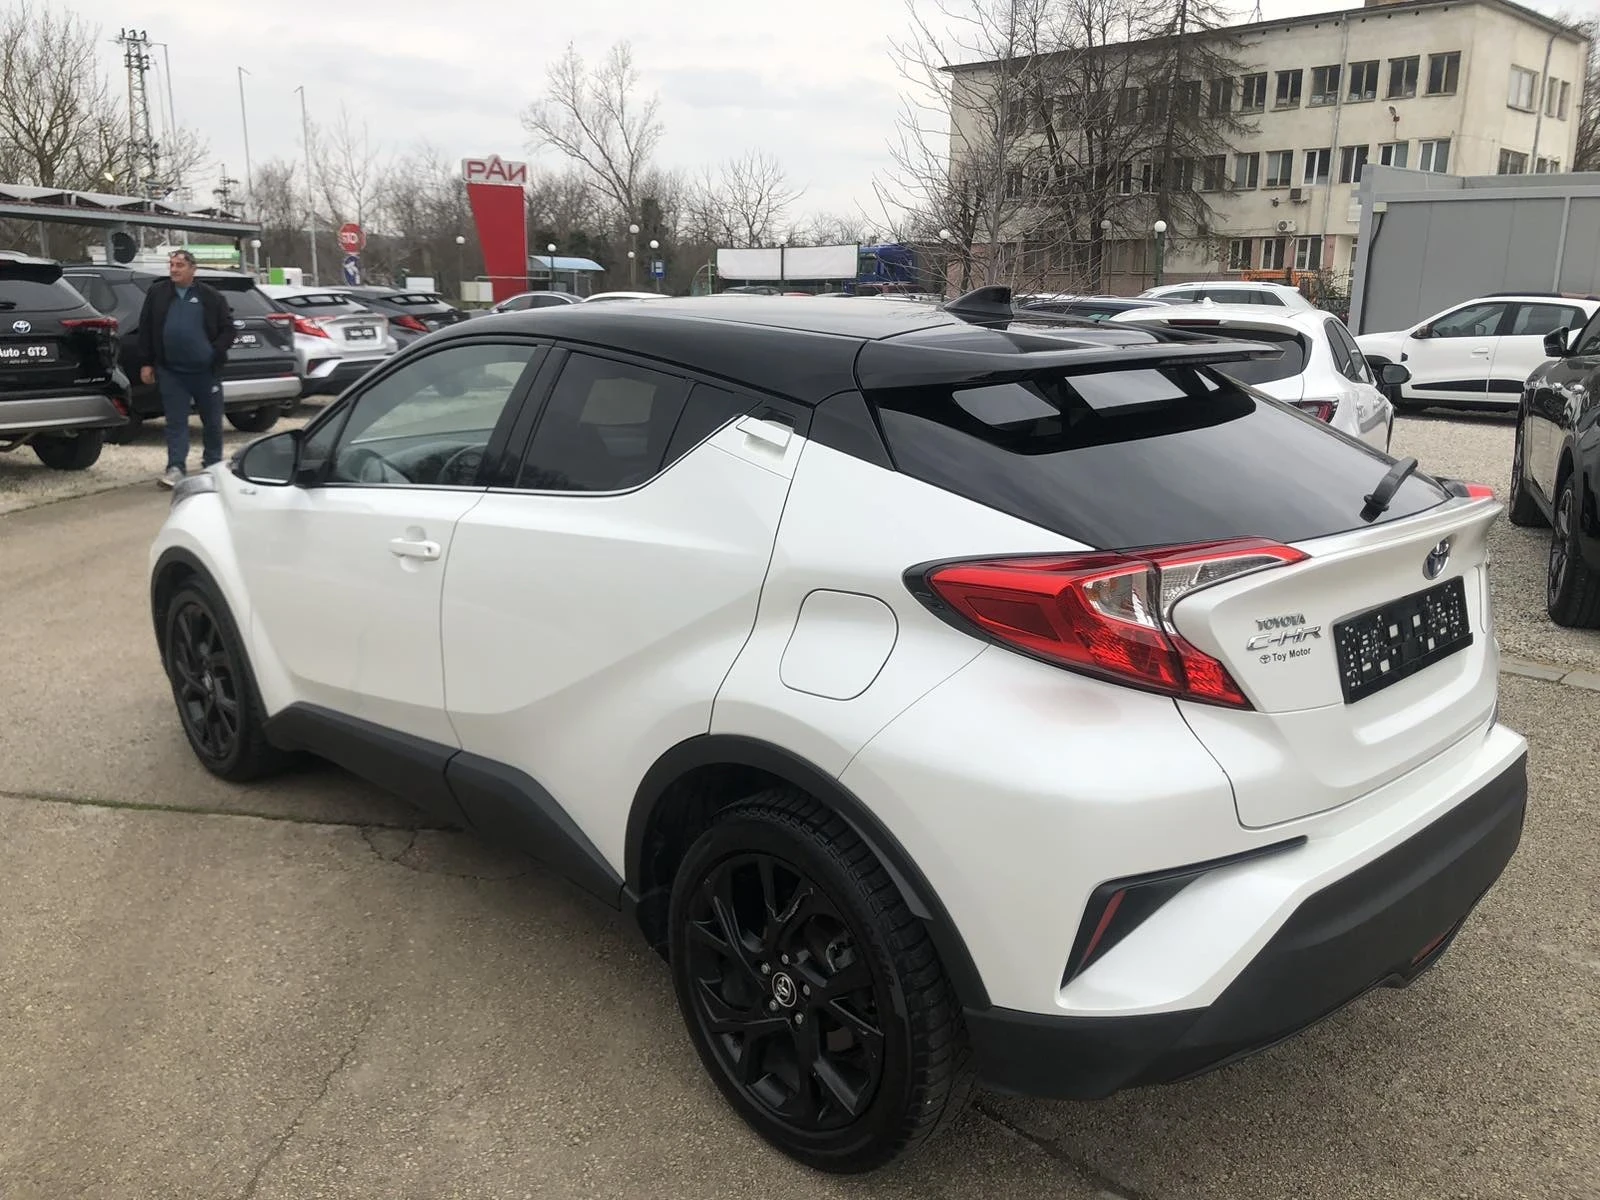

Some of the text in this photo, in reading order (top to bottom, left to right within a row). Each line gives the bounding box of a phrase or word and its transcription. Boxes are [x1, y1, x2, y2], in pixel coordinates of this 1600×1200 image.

[27, 346, 48, 357] GT3
[1256, 613, 1306, 631] TOYOTA
[1246, 625, 1322, 651] C-HR
[1272, 648, 1311, 662] Toy Motor
